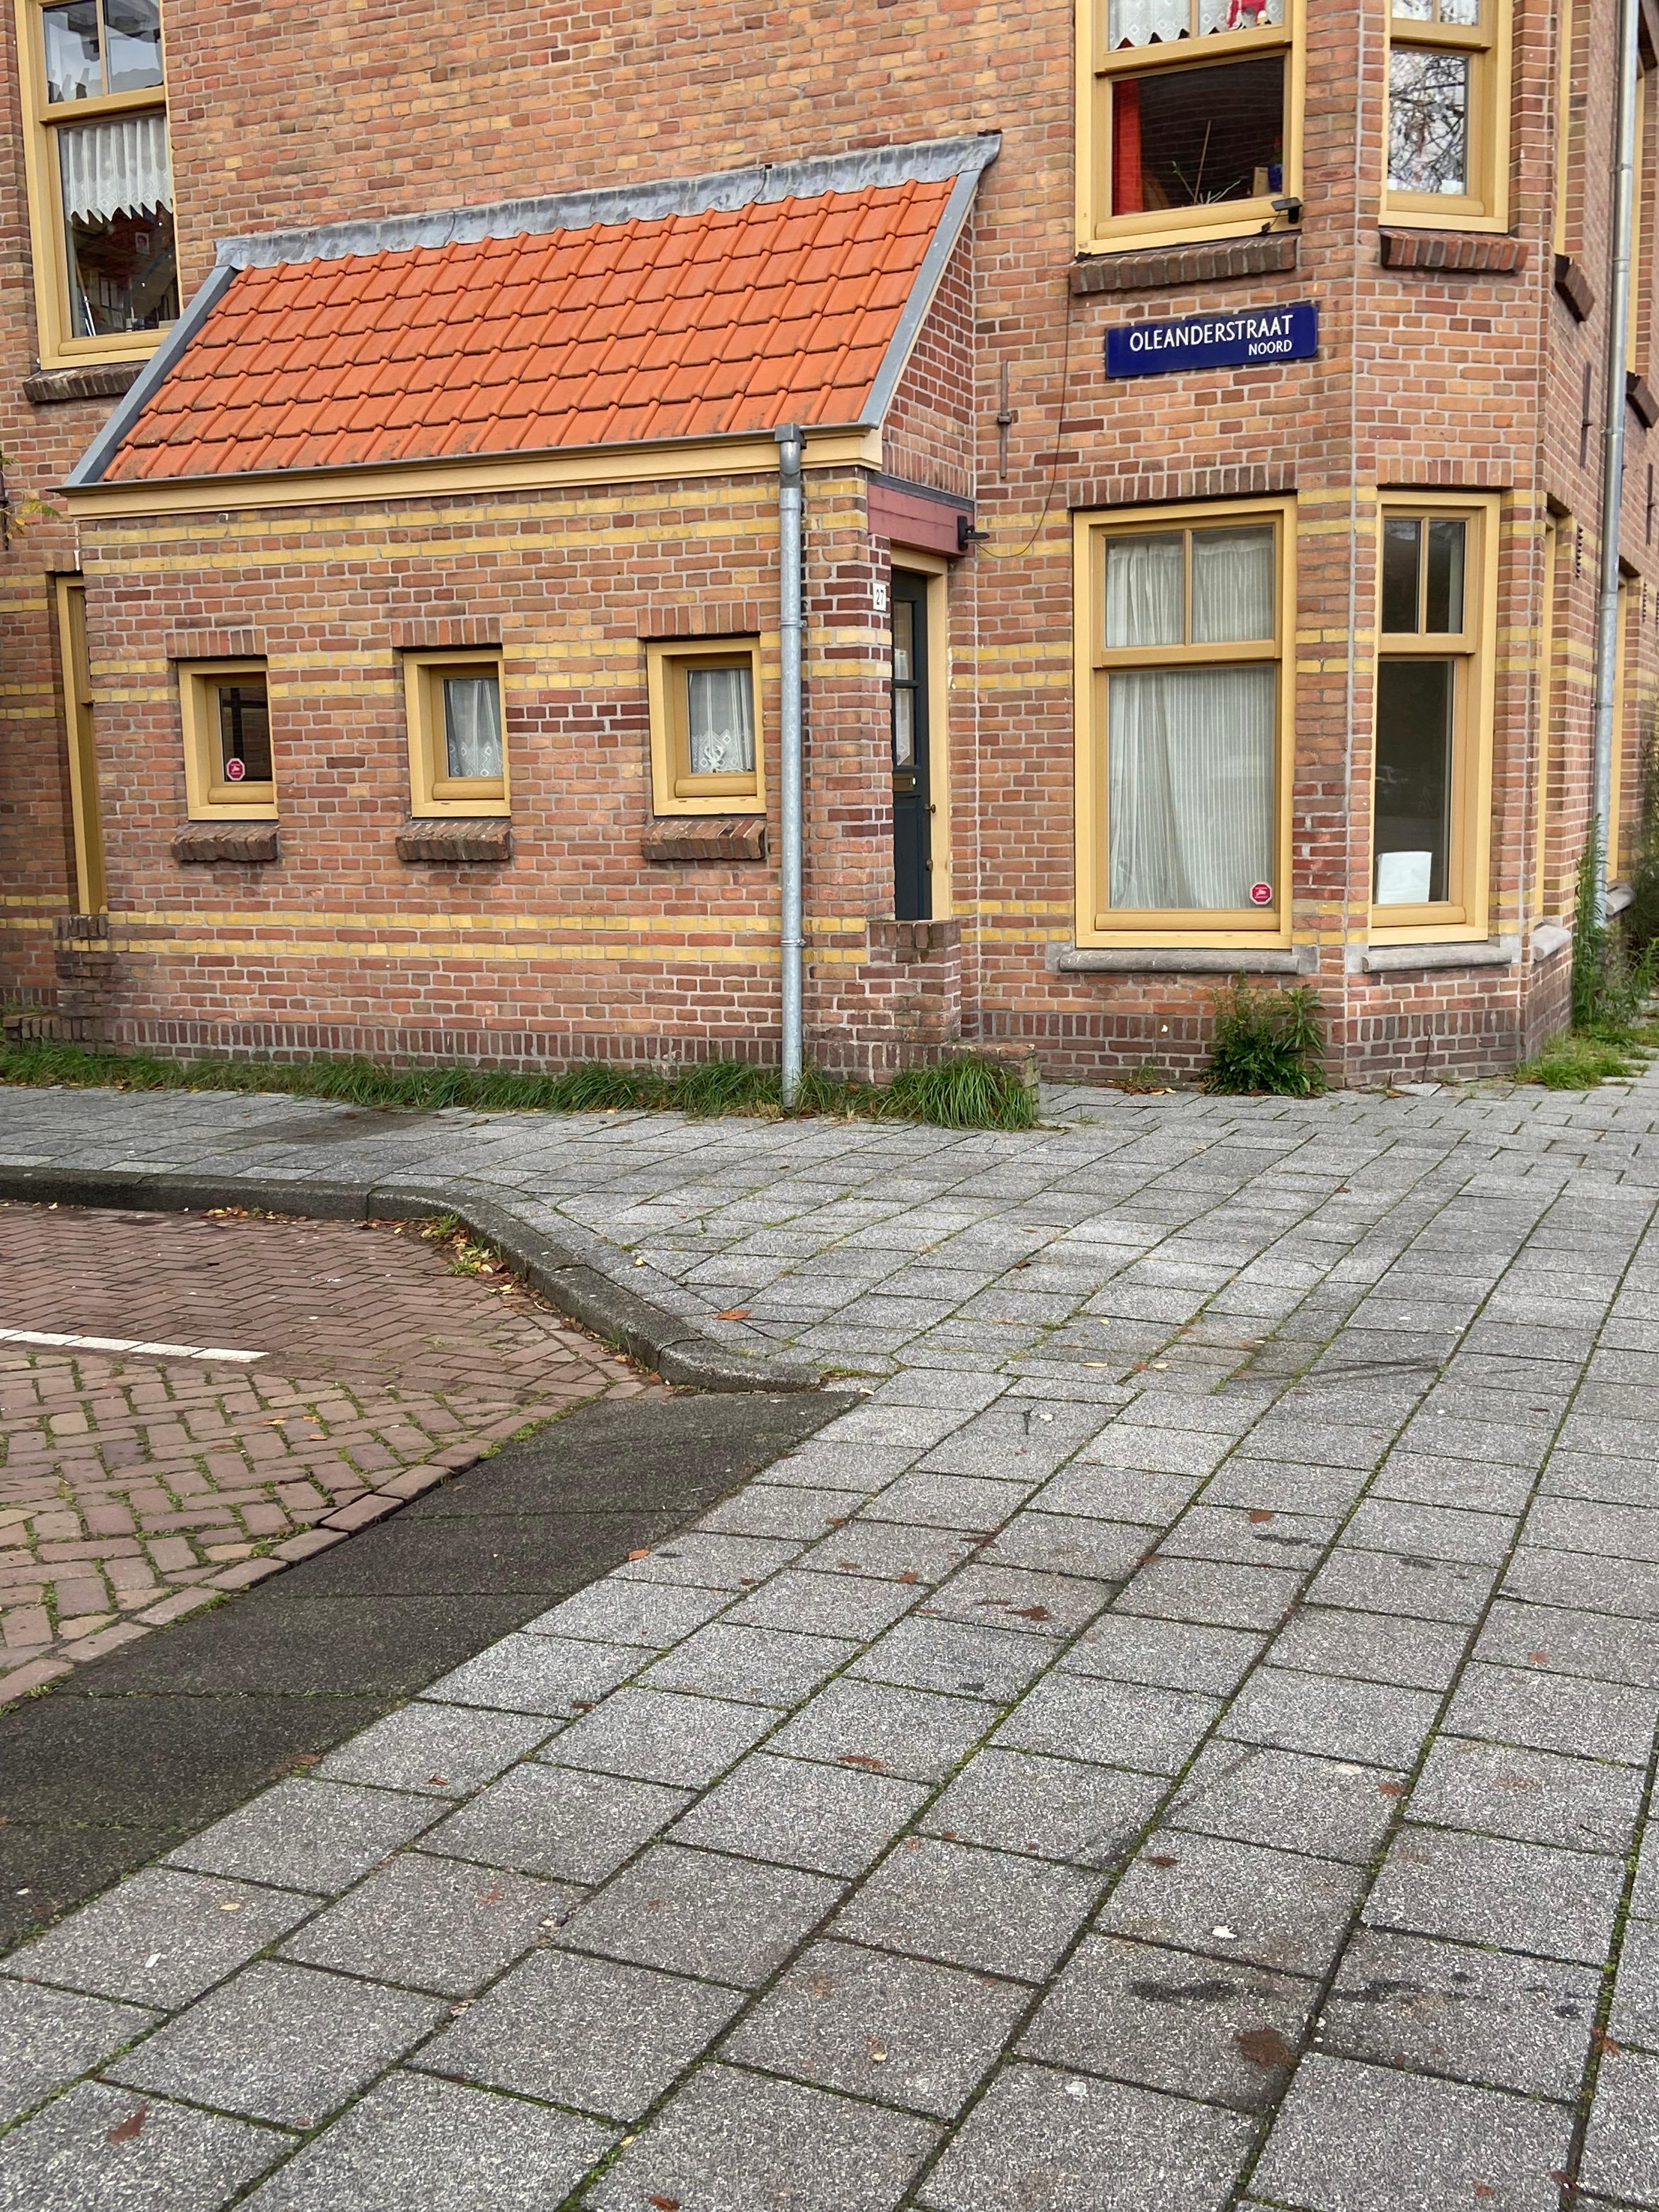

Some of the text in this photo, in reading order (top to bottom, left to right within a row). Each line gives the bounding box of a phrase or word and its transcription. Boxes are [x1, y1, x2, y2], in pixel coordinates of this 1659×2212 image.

[1130, 314, 1294, 352] OLEANDERSTRAAT
[1249, 340, 1293, 356] NOORD
[876, 589, 884, 606] 27
